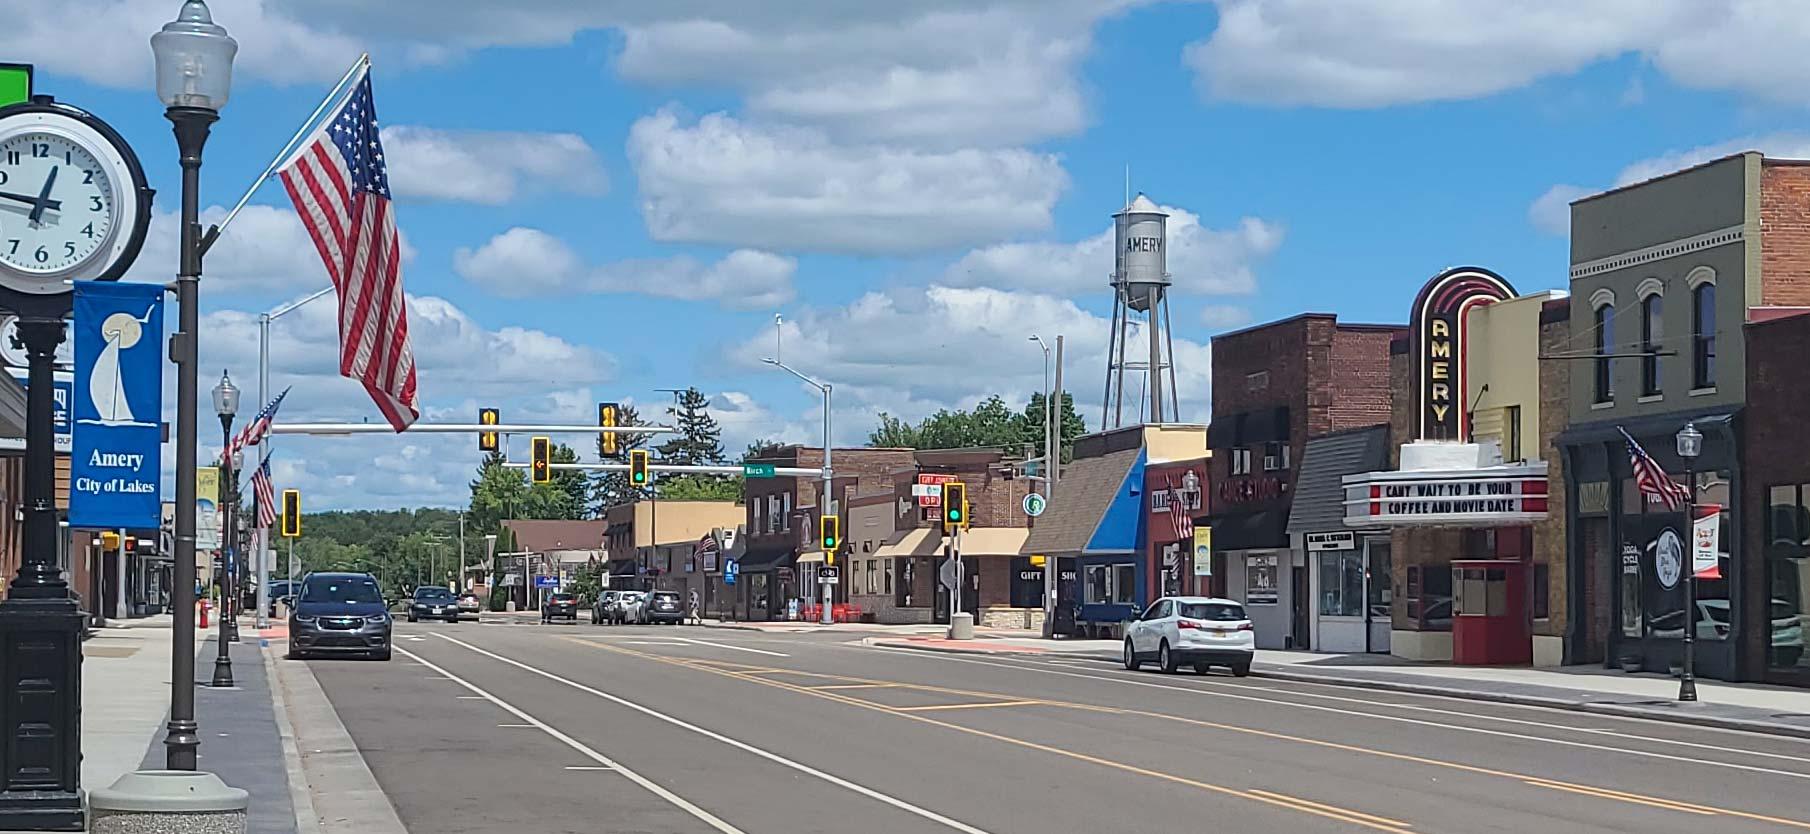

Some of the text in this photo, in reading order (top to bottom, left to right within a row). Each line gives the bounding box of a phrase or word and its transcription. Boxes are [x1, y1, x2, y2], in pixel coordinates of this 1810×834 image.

[8, 151, 20, 165] 11
[32, 143, 49, 158] 12
[65, 151, 71, 165] 1
[0, 171, 8, 184] 0
[82, 170, 93, 184] 2
[90, 196, 103, 211] 3
[80, 222, 93, 238] 4
[8, 239, 21, 254] 7
[64, 242, 75, 257] 5
[1127, 237, 1162, 253] AMERY
[35, 245, 48, 262] 6
[1431, 319, 1450, 422] AMERY
[88, 448, 144, 472] Amery
[76, 477, 155, 495] City of Lakes
[1386, 482, 1512, 497] CANT WAIT TO BE YOUR
[1388, 499, 1515, 514] COFFEE AND MOVIE DATE
[1020, 571, 1042, 580] GIFT
